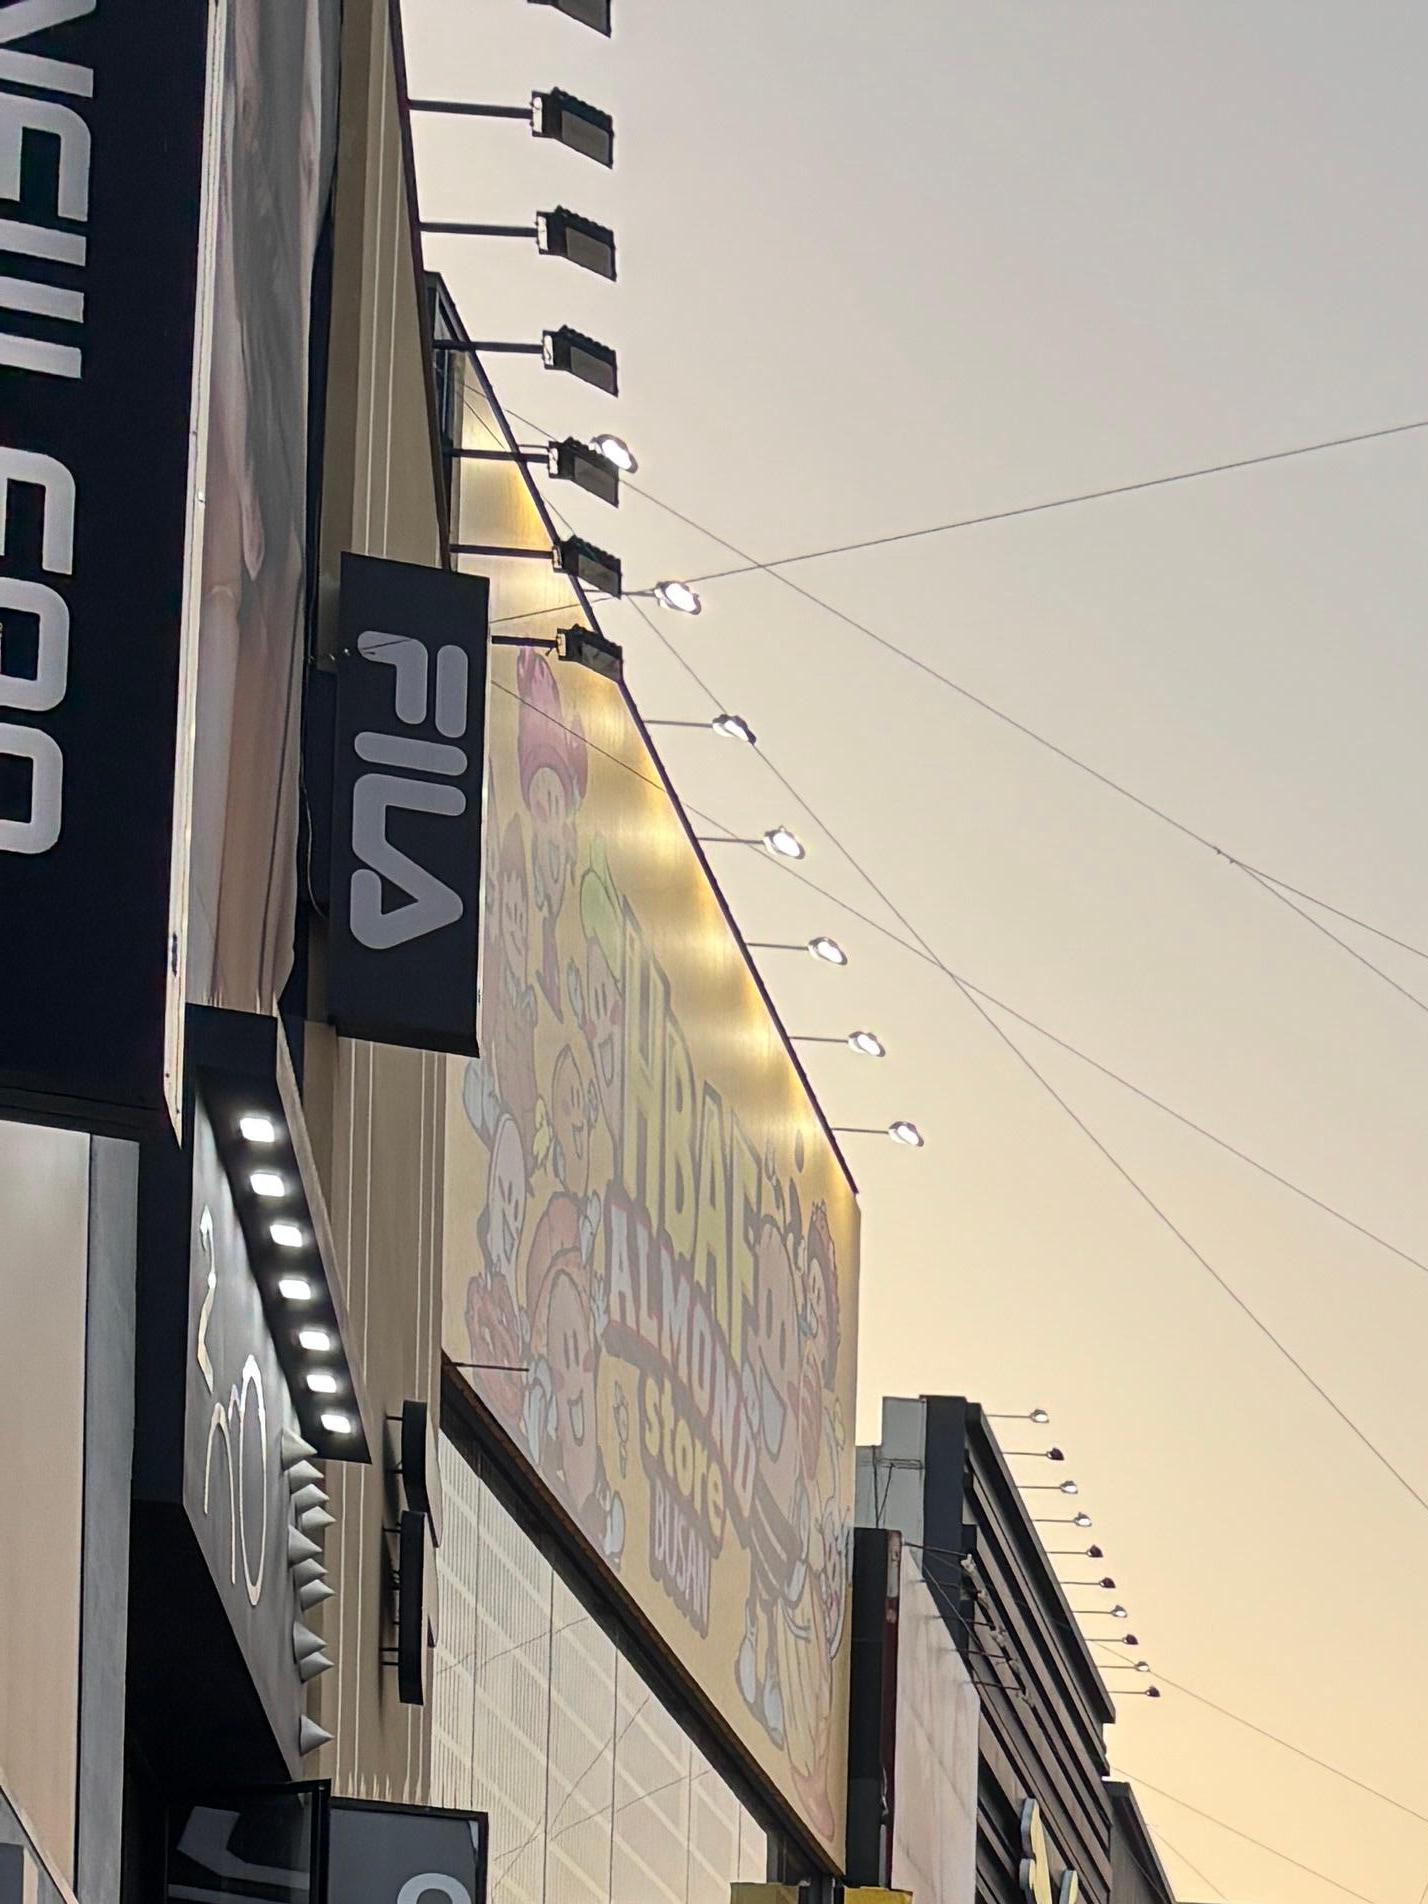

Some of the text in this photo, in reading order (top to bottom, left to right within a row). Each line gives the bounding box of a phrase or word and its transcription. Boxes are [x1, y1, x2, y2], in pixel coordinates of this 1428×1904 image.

[350, 629, 469, 950] FILA
[622, 908, 764, 1362] HBAF
[606, 1206, 758, 1519] ALMOND
[643, 1368, 724, 1536] store
[654, 1498, 712, 1635] BUSAN
